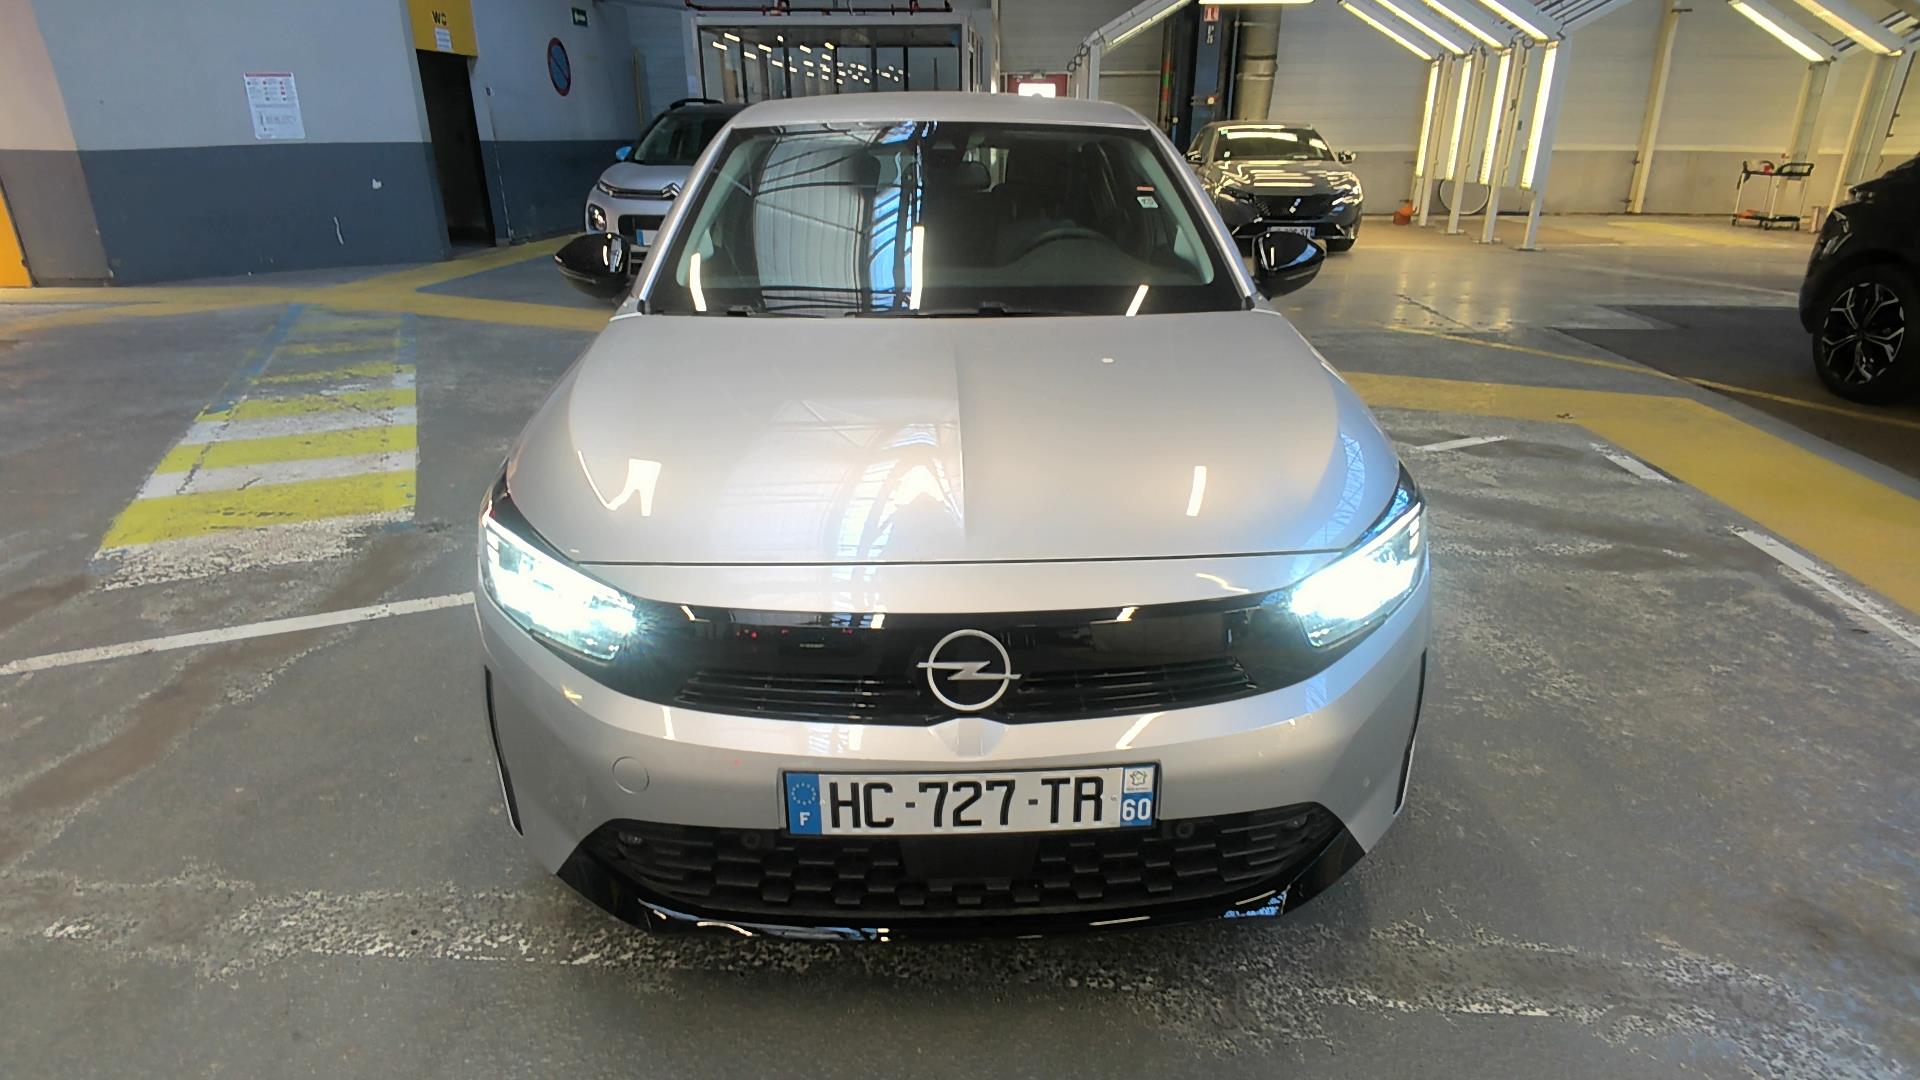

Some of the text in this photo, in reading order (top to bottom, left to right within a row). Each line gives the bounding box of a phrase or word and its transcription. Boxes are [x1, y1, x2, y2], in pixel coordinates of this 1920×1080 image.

[432, 10, 447, 26] WC
[829, 776, 1104, 828] HC-727-TR
[1122, 798, 1151, 821] 60
[800, 812, 810, 826] F
